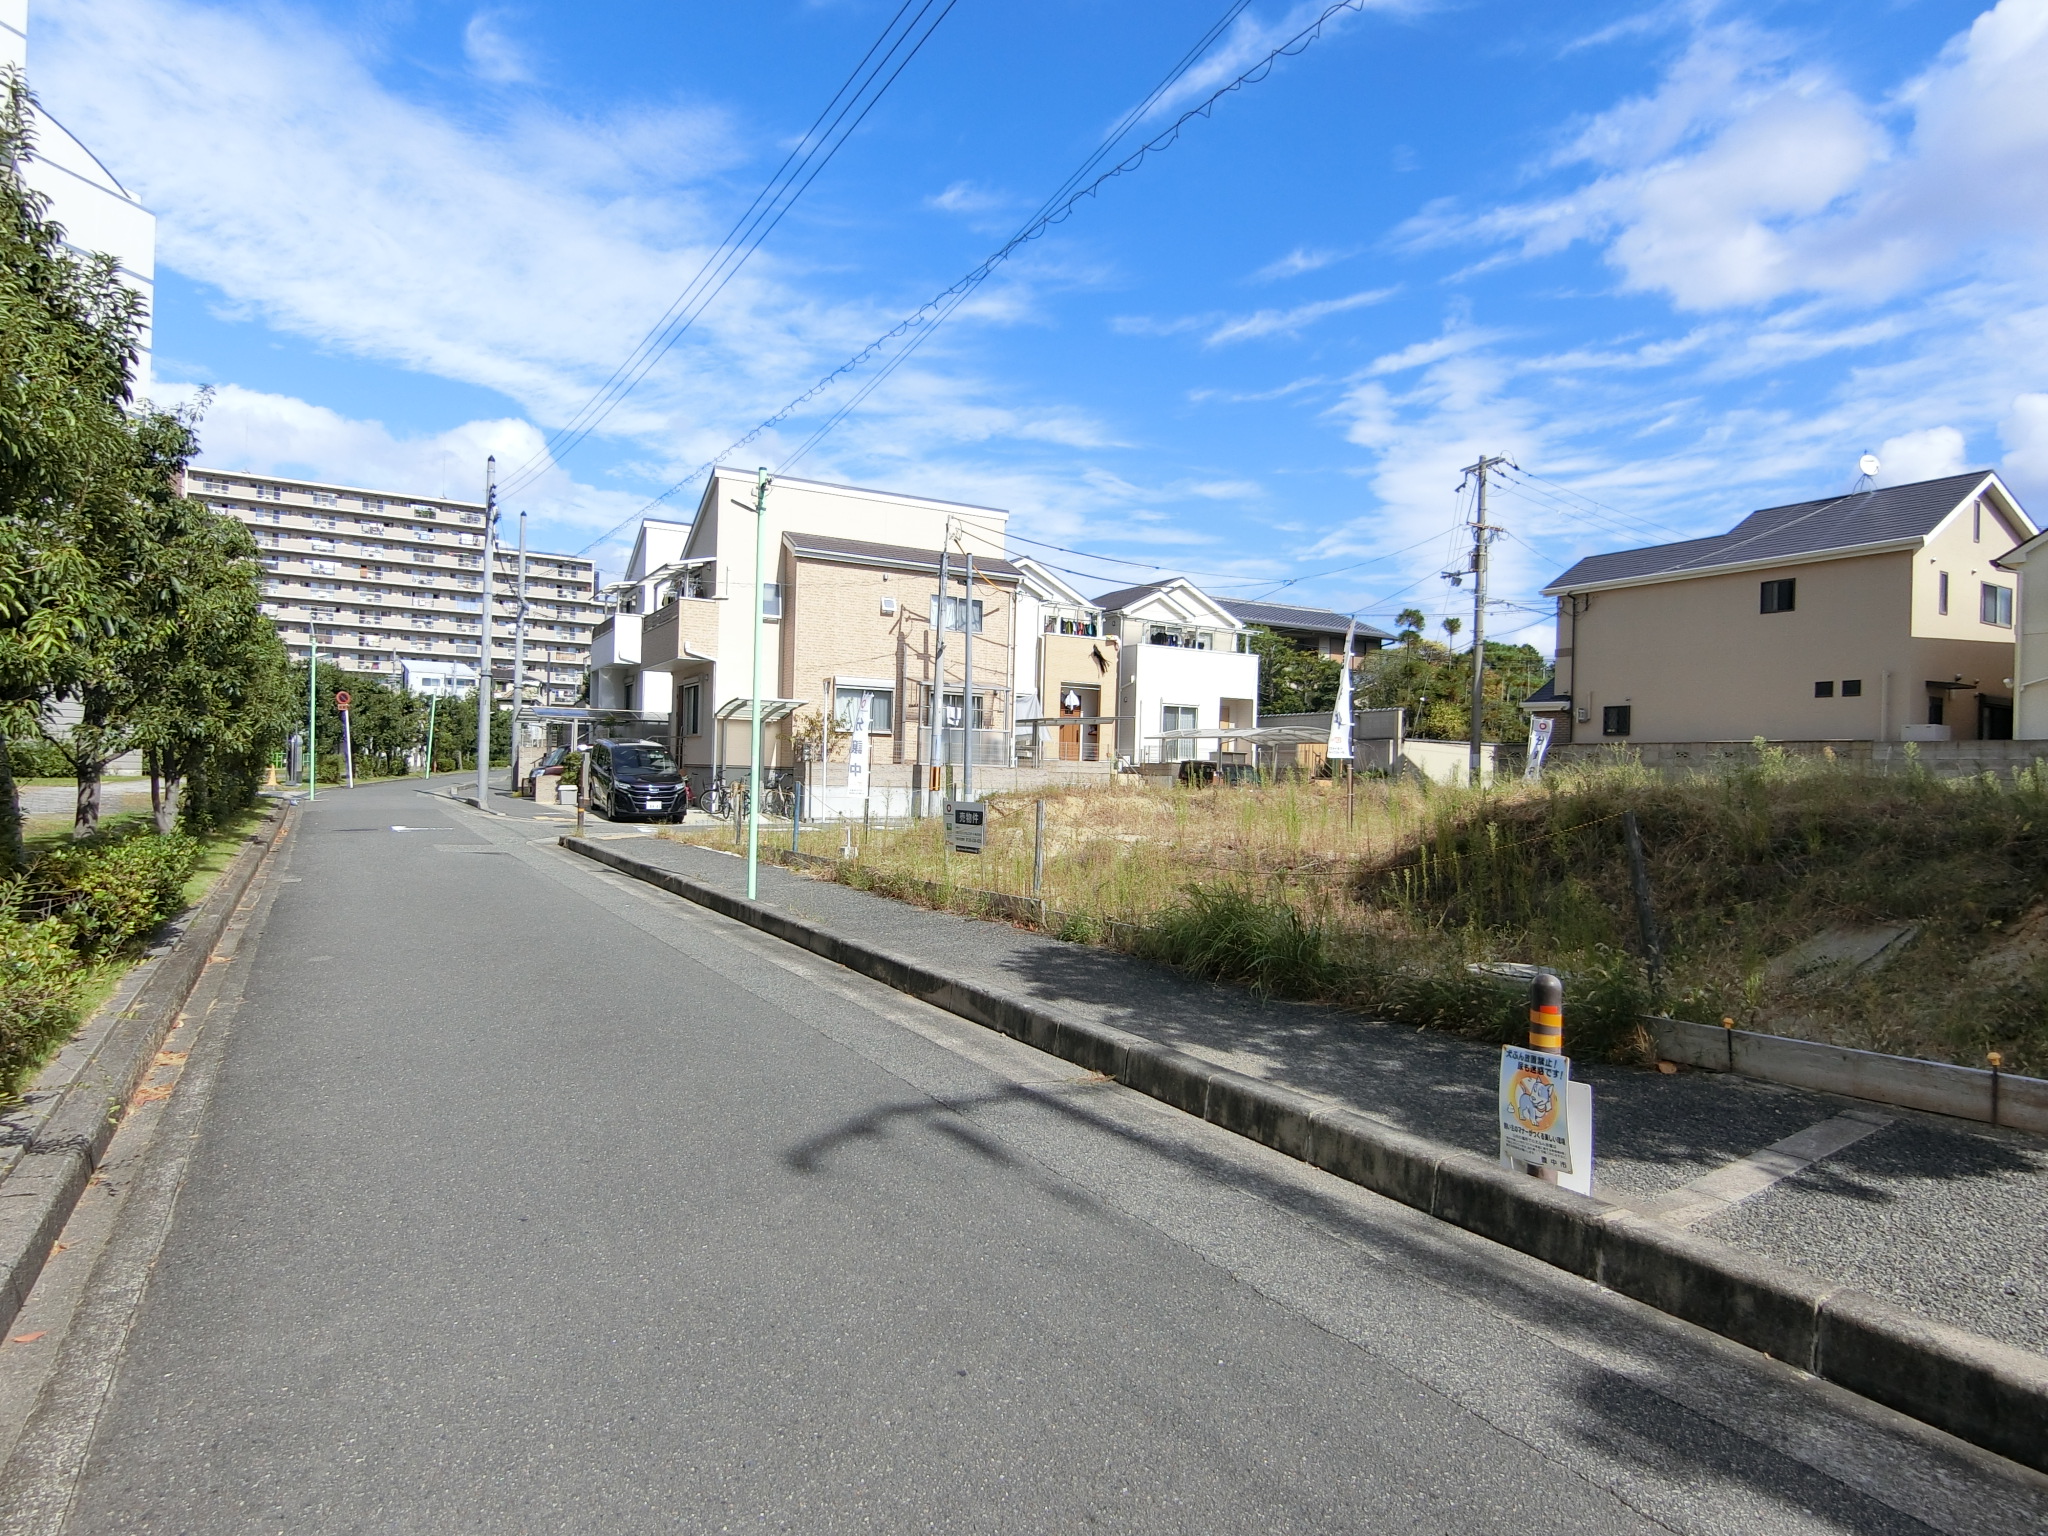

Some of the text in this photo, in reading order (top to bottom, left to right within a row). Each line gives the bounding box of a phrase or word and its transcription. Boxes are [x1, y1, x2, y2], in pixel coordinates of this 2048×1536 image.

[850, 717, 864, 776] 分譲中
[959, 811, 979, 824] 売物件
